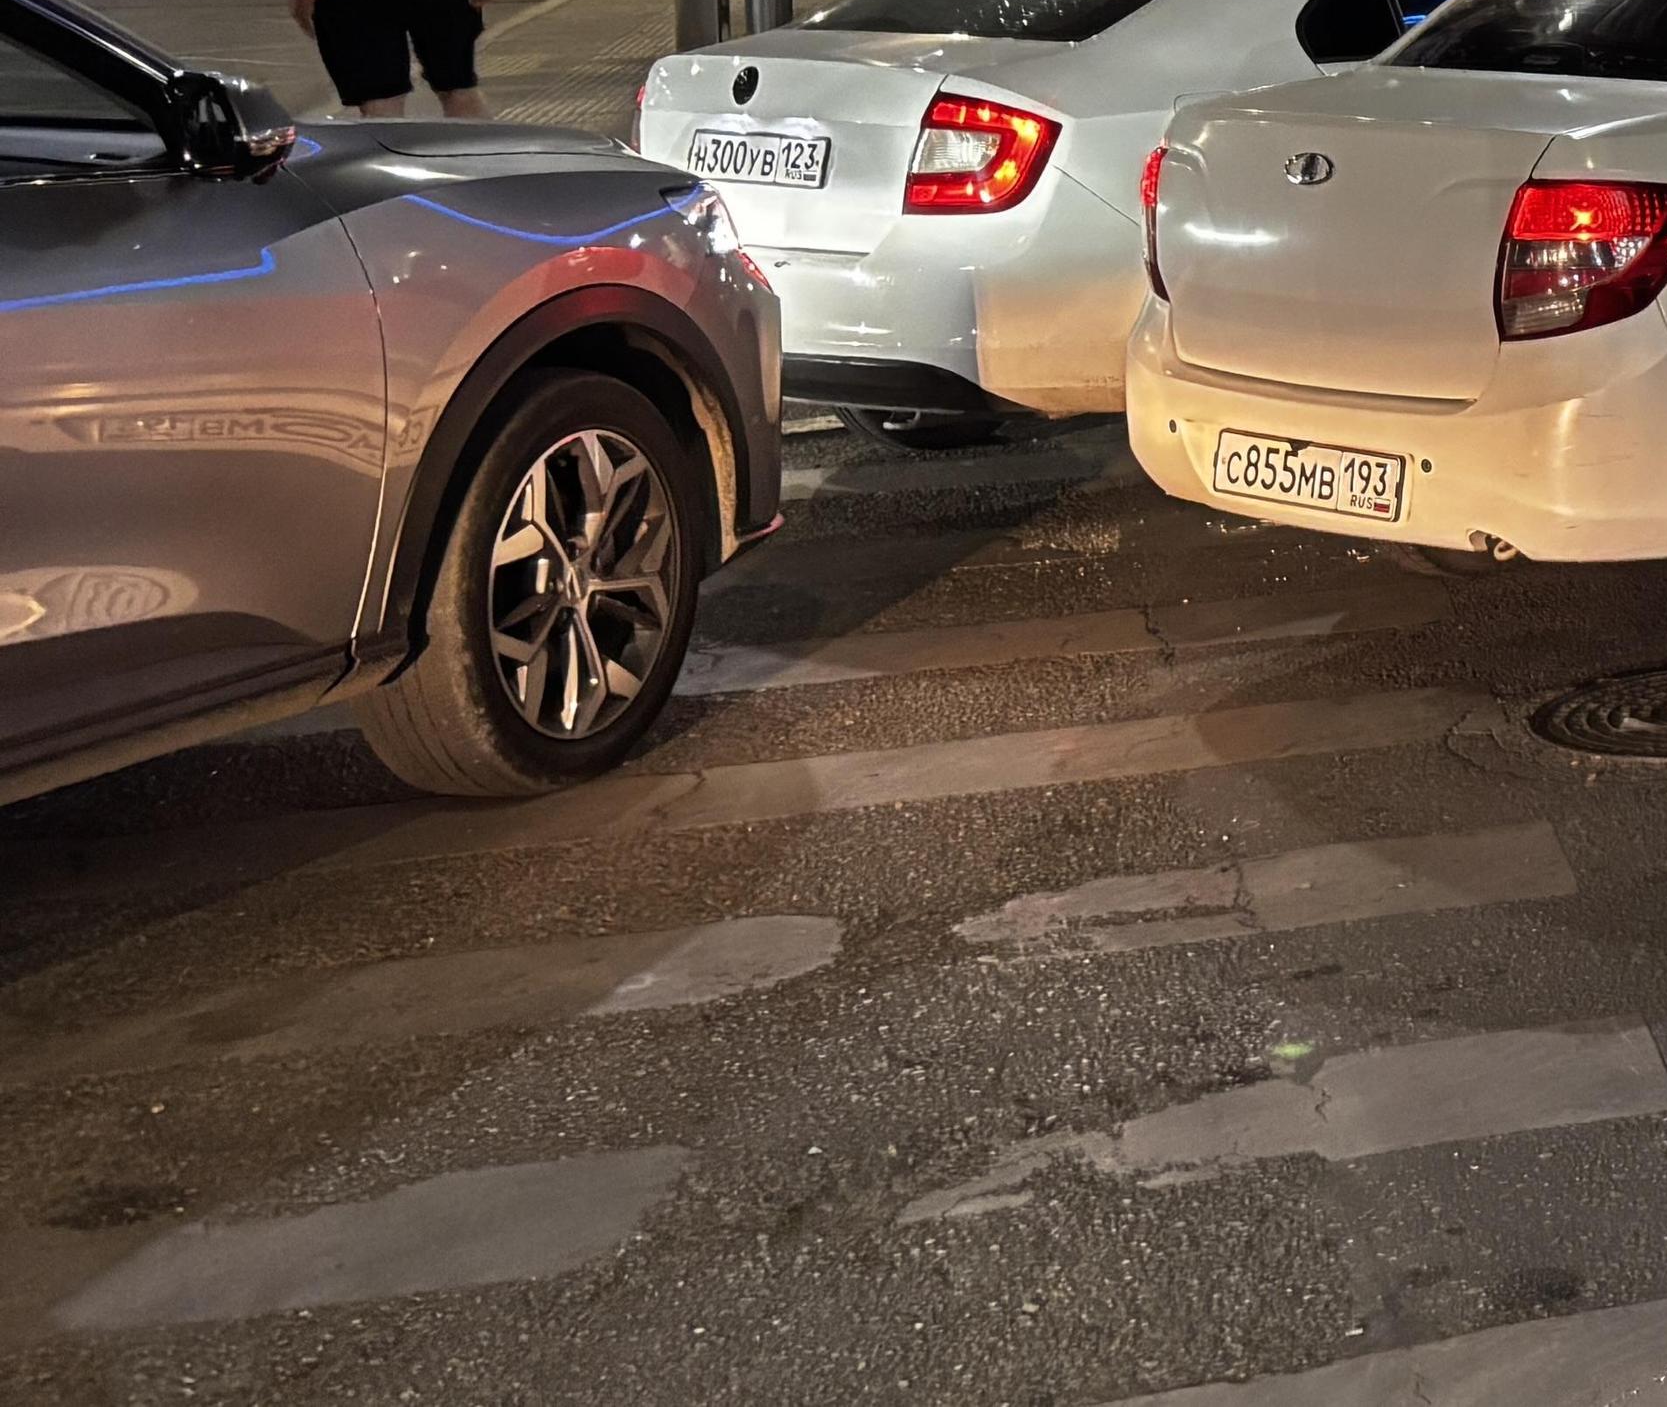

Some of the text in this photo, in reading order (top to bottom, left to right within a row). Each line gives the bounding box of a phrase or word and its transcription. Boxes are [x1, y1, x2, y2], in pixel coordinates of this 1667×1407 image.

[782, 141, 818, 170] 123
[1227, 444, 1388, 500] С855МВ 193
[1350, 494, 1373, 510] RUS
